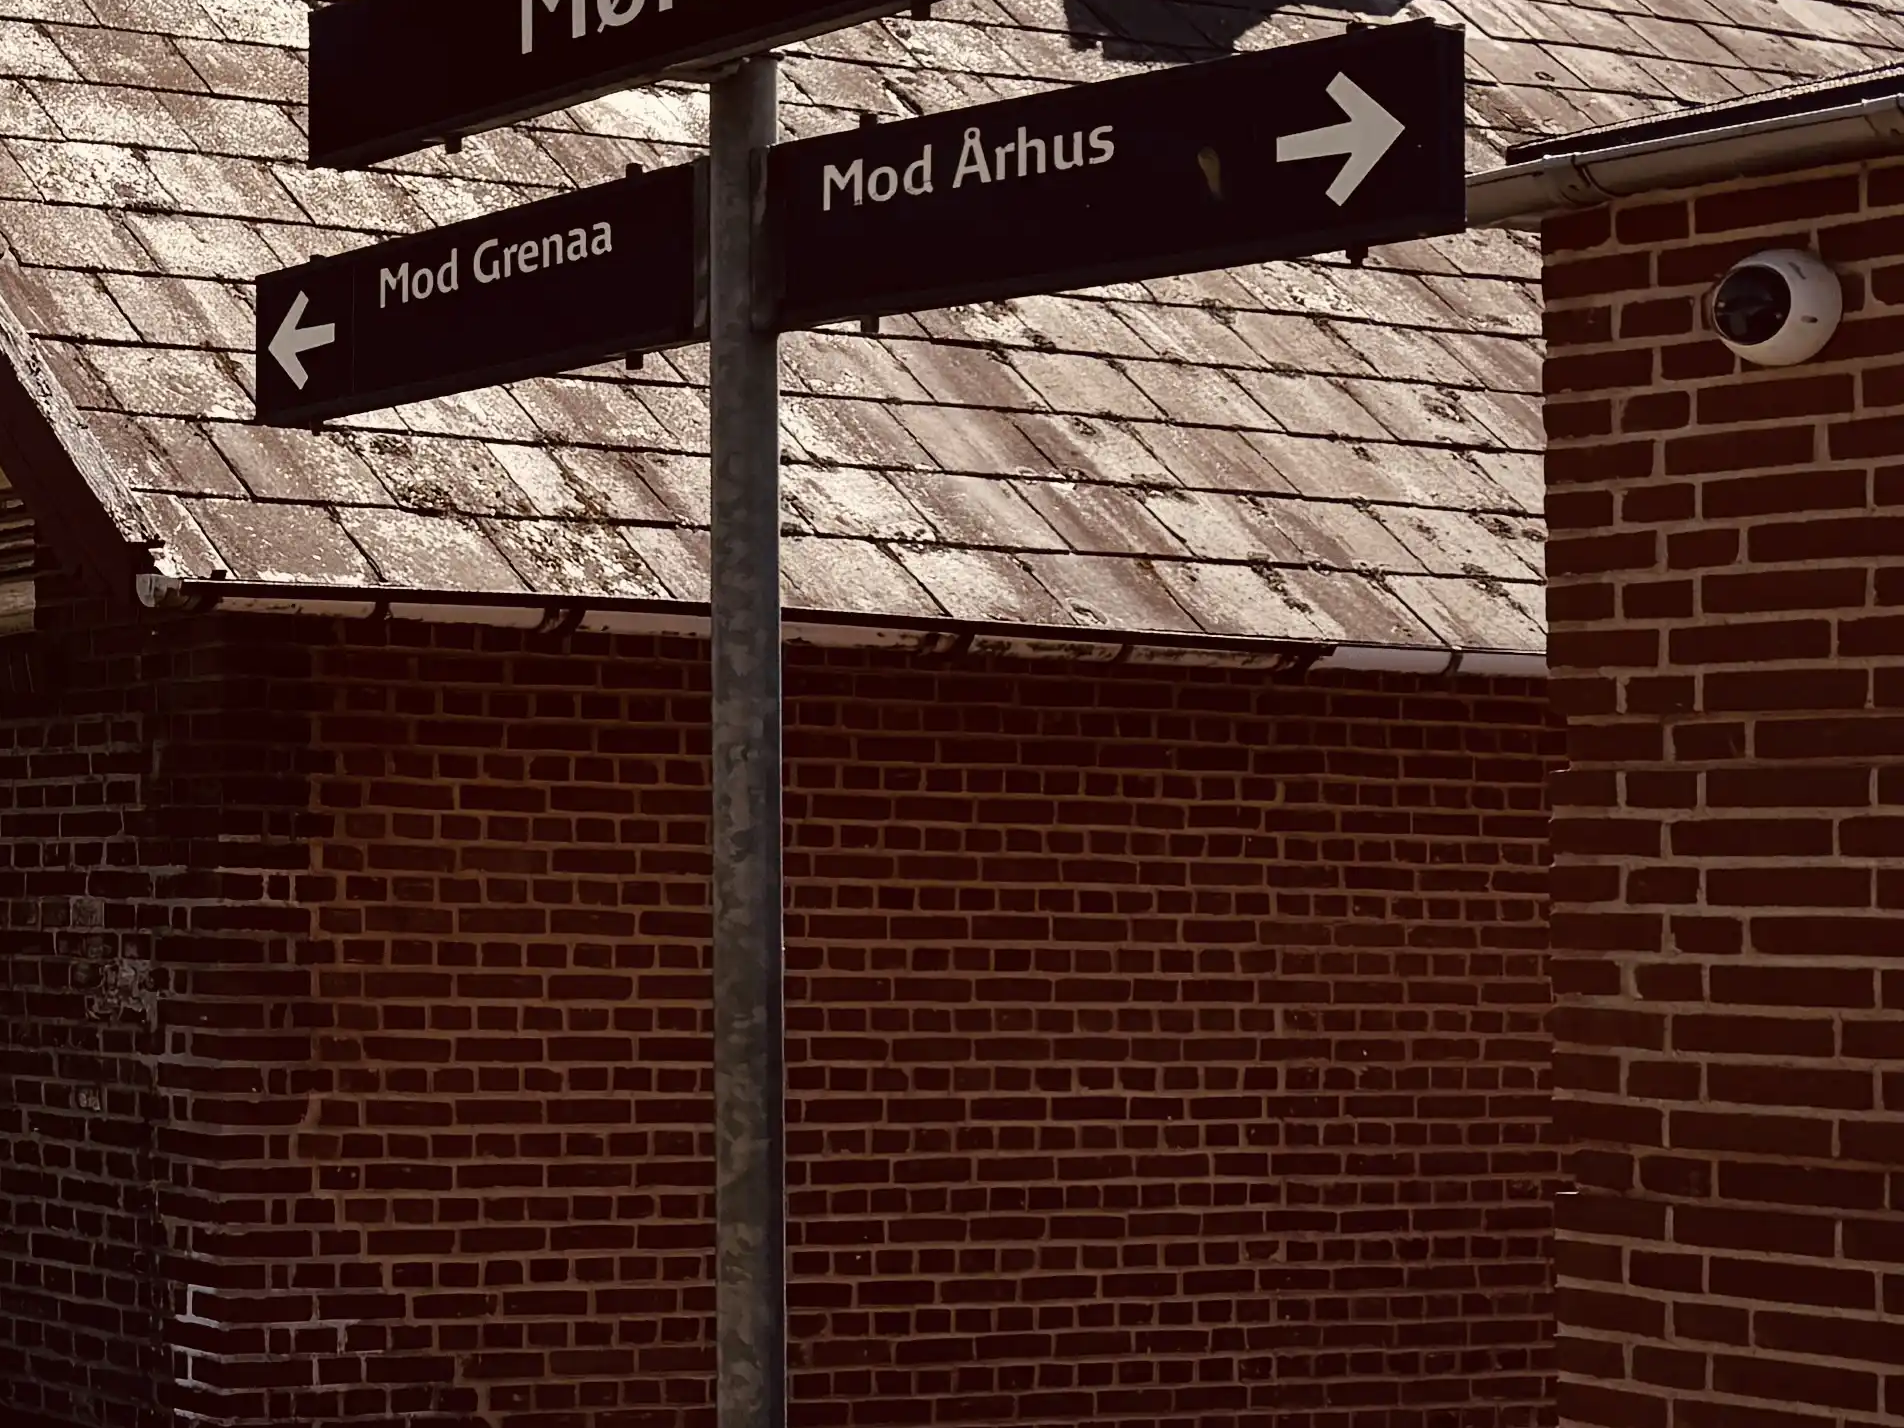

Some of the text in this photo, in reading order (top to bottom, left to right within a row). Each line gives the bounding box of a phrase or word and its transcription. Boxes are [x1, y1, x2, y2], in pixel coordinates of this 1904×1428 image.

[822, 124, 1116, 212] Mod Århus
[379, 221, 614, 310] Mod Grenaa
